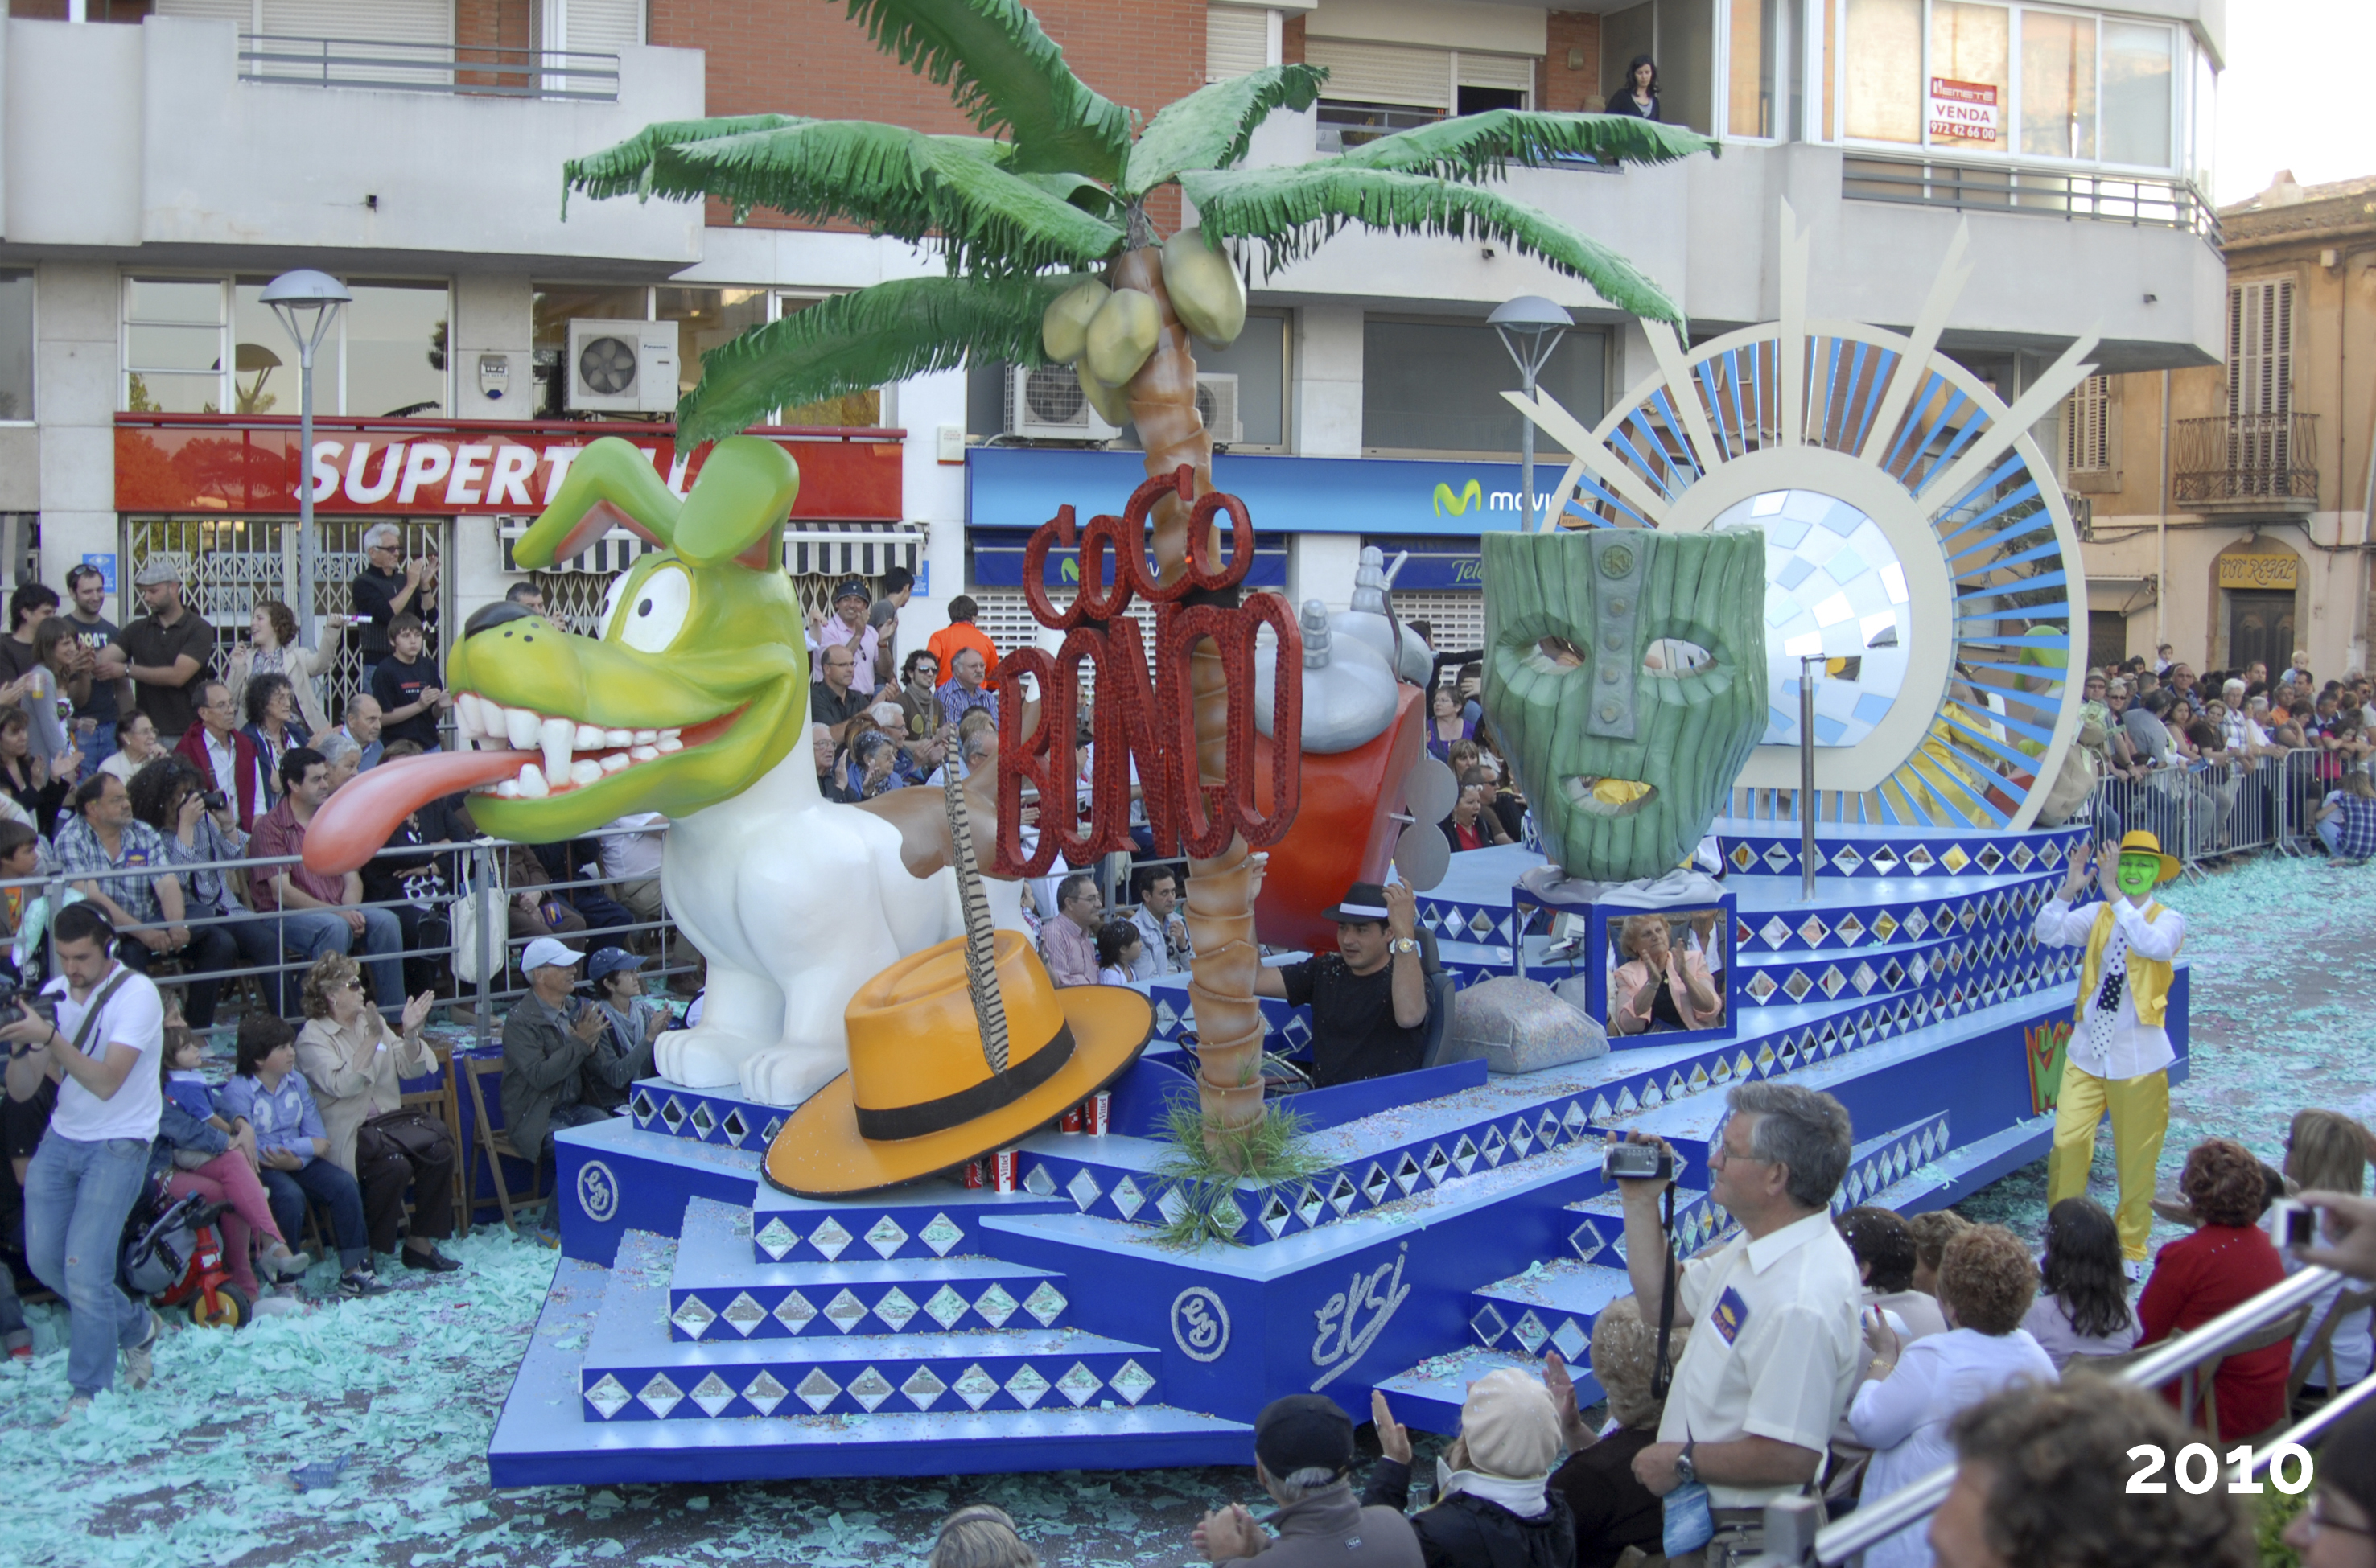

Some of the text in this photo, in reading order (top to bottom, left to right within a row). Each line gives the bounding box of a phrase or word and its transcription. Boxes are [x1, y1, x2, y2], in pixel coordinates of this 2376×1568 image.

[1936, 104, 1991, 123] VENDA
[1931, 121, 1995, 140] 972 42 66 00
[990, 592, 1302, 878] BONGO
[1000, 1155, 1008, 1177] Vittel
